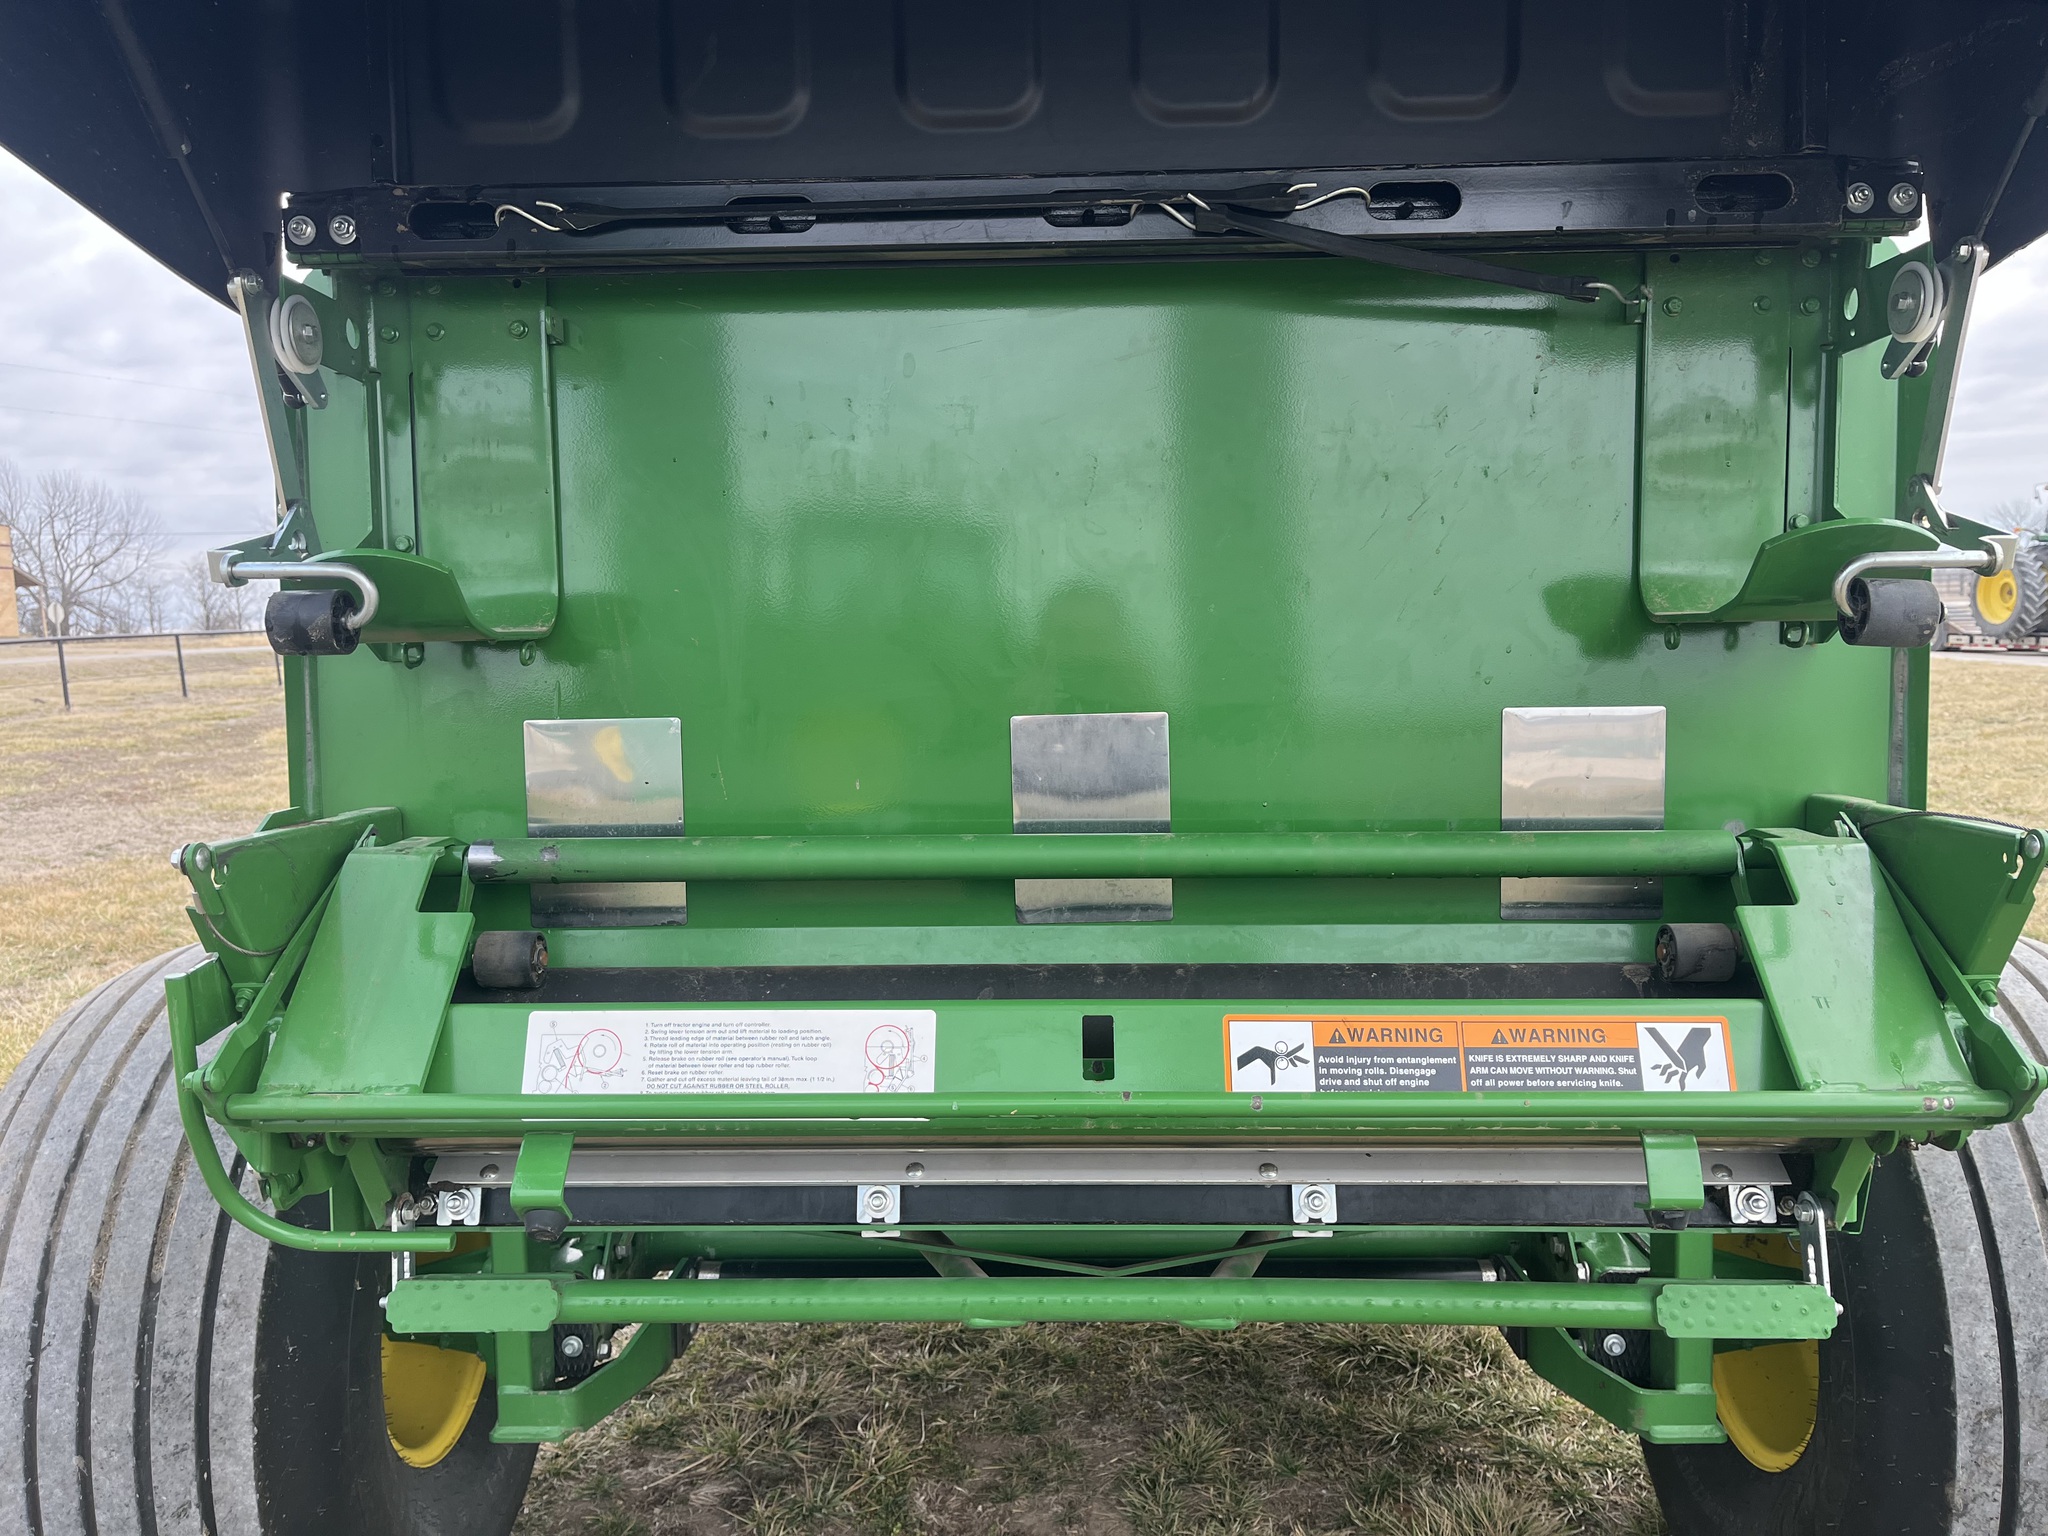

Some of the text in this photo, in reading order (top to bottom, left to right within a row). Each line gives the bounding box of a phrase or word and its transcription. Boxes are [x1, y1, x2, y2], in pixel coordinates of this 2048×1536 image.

[1347, 1028, 1443, 1042] WARNING
[1509, 1028, 1605, 1043] WARNING
[1346, 1056, 1371, 1065] injury
[1396, 1056, 1456, 1066] entanglement
[1330, 1067, 1362, 1076] moving
[1390, 1067, 1436, 1076] Disengage
[1385, 1078, 1397, 1086] off
[1399, 1078, 1429, 1088] engine
[1557, 1079, 1597, 1088] servicing
